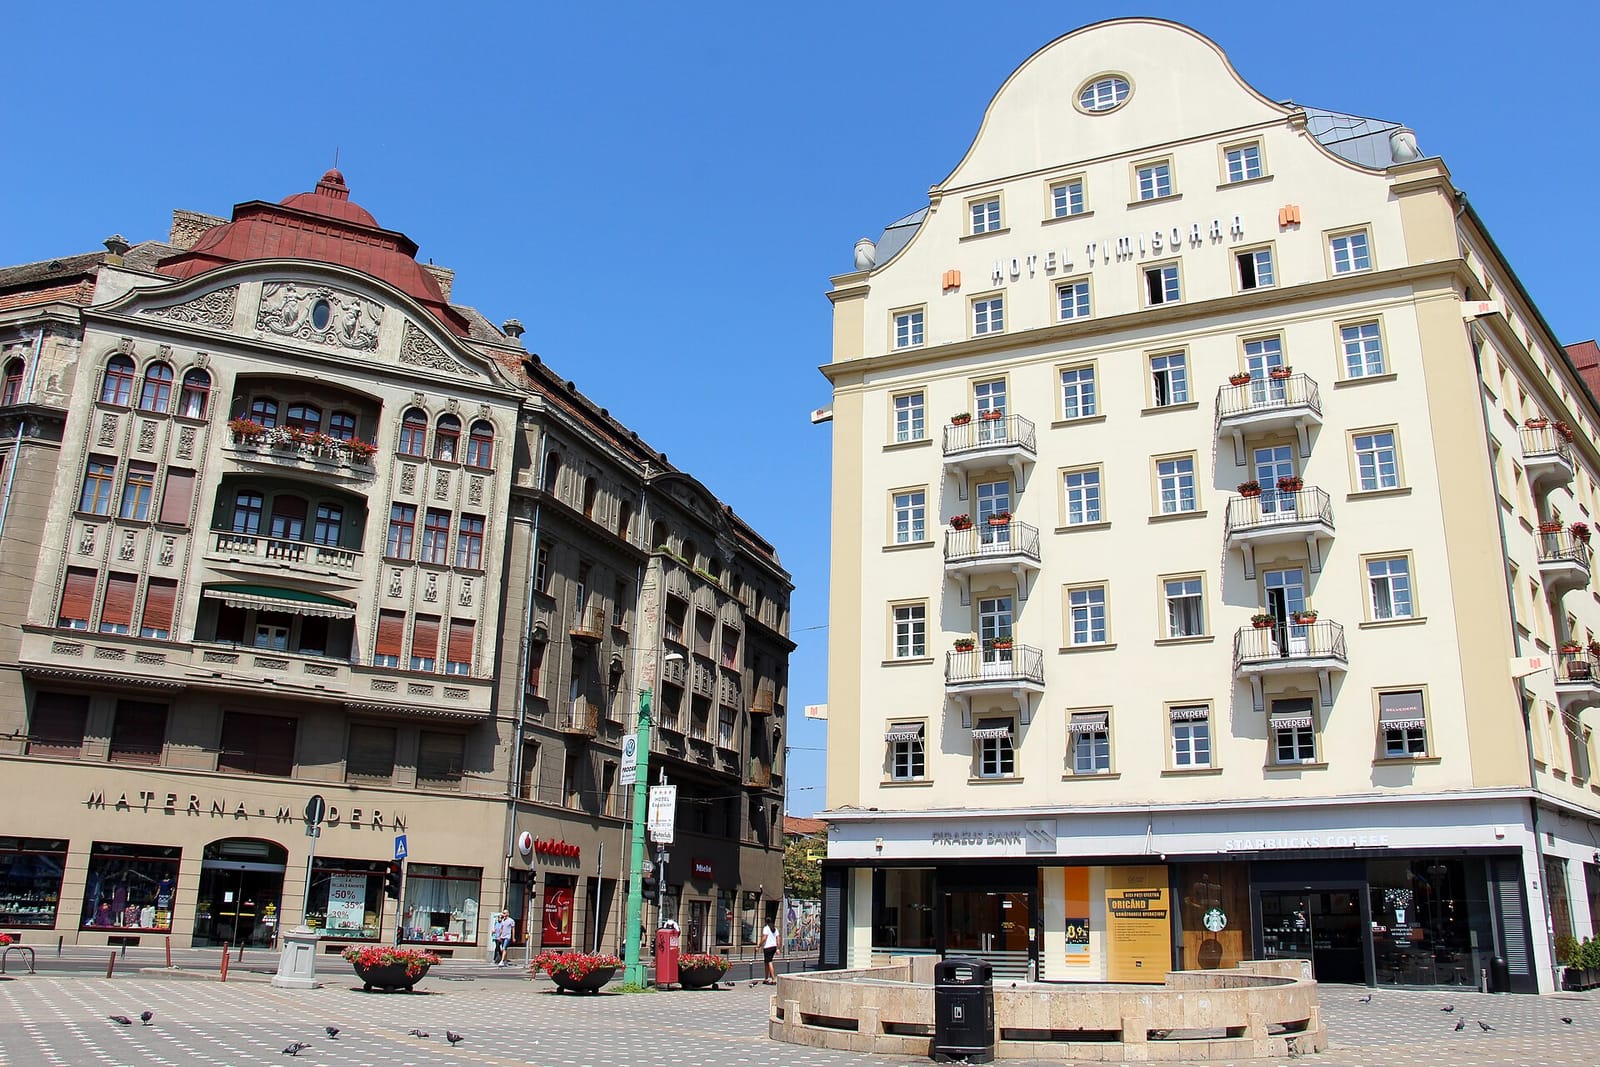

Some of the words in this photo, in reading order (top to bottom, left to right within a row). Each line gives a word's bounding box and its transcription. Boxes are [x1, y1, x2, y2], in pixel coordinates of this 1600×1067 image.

[992, 247, 1074, 281] HOTEL
[1382, 720, 1425, 730] BELVEDERE
[87, 788, 249, 817] MATERNA
[932, 831, 983, 846] PIRAEUS
[987, 830, 1022, 846] BANK
[1225, 835, 1320, 850] STARBUCKS
[1327, 834, 1389, 847] COFFEE
[534, 837, 580, 857] vodafone
[331, 889, 356, 899] -50%
[1112, 898, 1146, 909] ORICÂND
